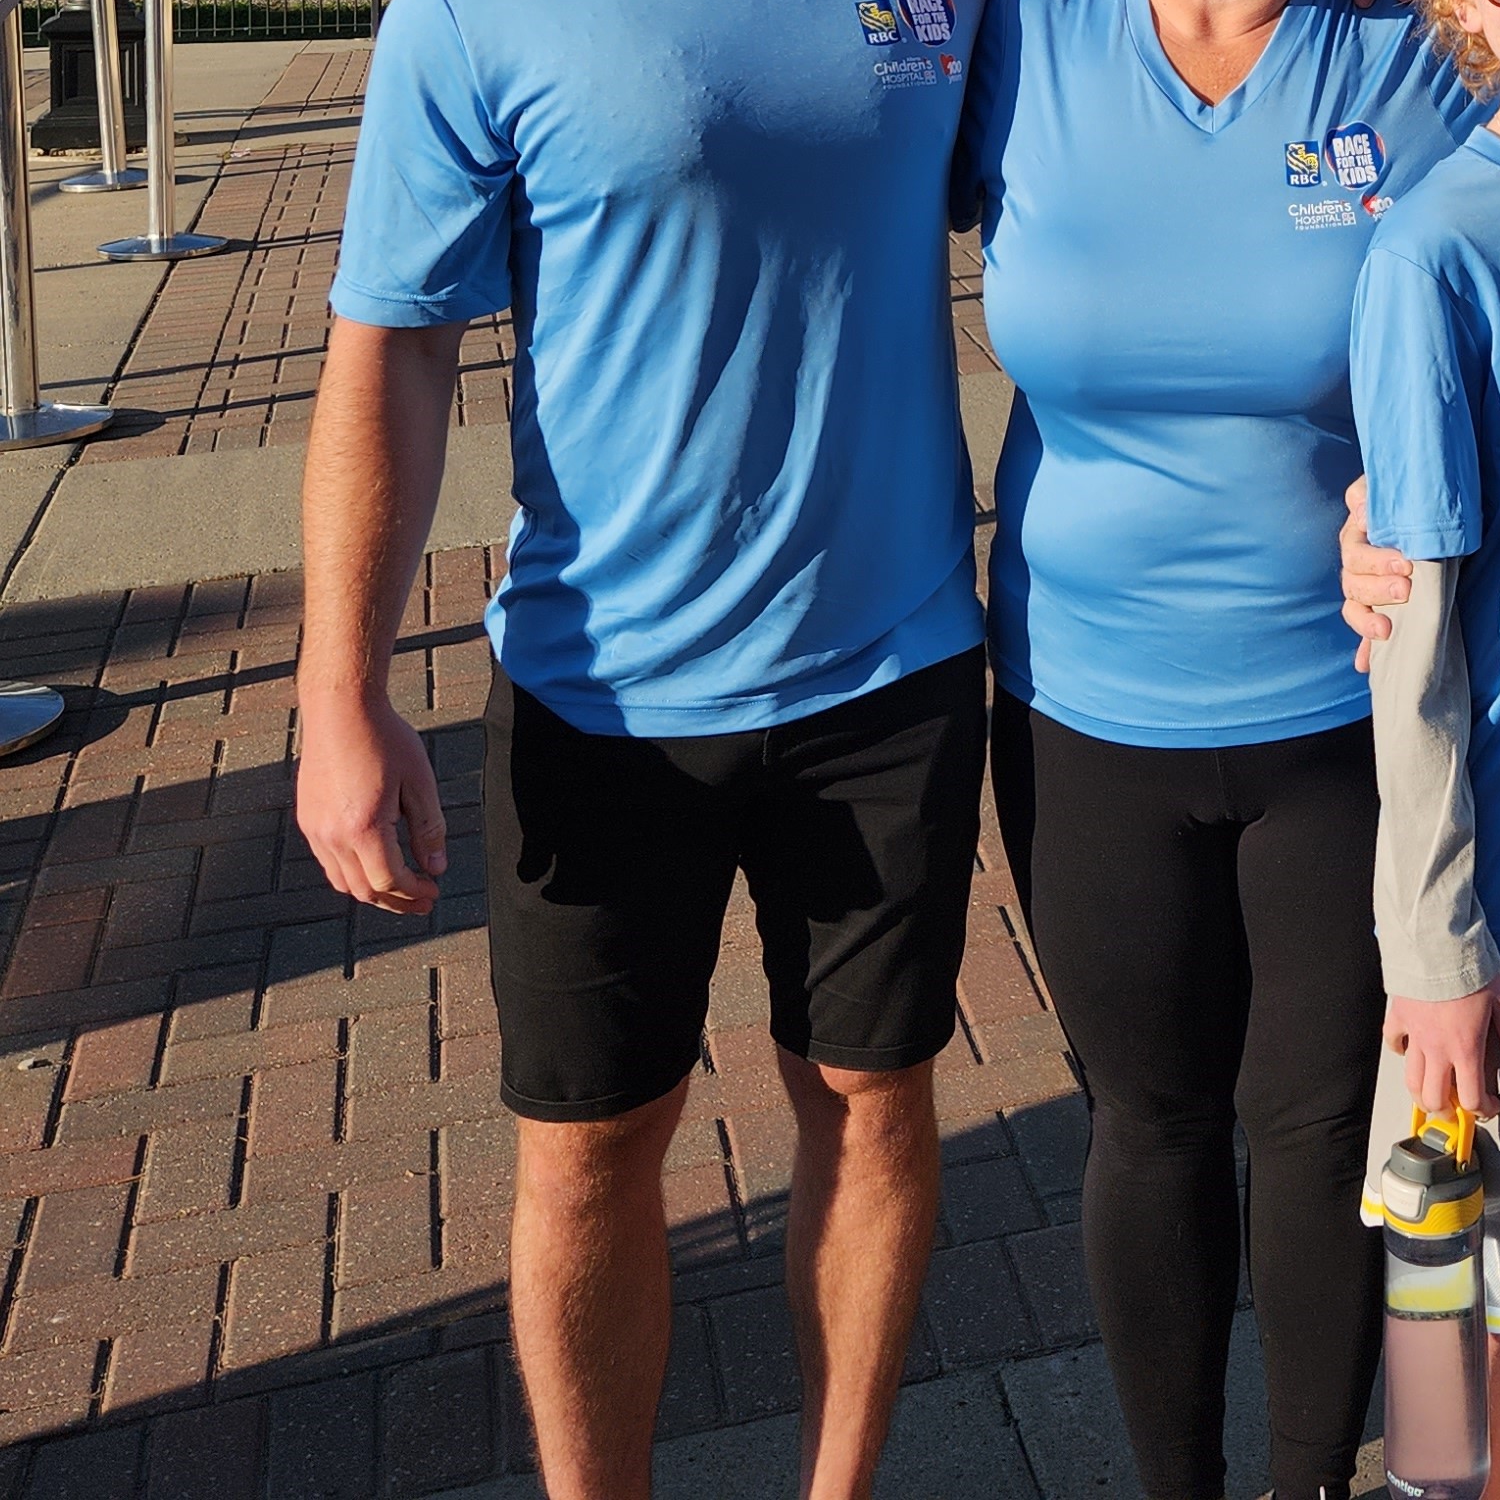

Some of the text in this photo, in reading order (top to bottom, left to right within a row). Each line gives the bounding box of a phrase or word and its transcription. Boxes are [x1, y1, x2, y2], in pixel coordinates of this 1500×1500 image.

[912, 11, 947, 25] FOR THE
[868, 30, 898, 44] RBC
[915, 23, 951, 42] KIDS
[874, 59, 933, 76] Children's
[947, 60, 962, 75] 100
[882, 73, 924, 84] HOSPITAL
[1332, 133, 1371, 157] RACE
[1335, 154, 1374, 168] FOR THE
[1290, 174, 1319, 185] RBC
[1338, 166, 1378, 186] KIDS
[1288, 202, 1352, 216] Children's
[1295, 214, 1341, 226] HOSPITAL
[1387, 1470, 1421, 1497] contigo
